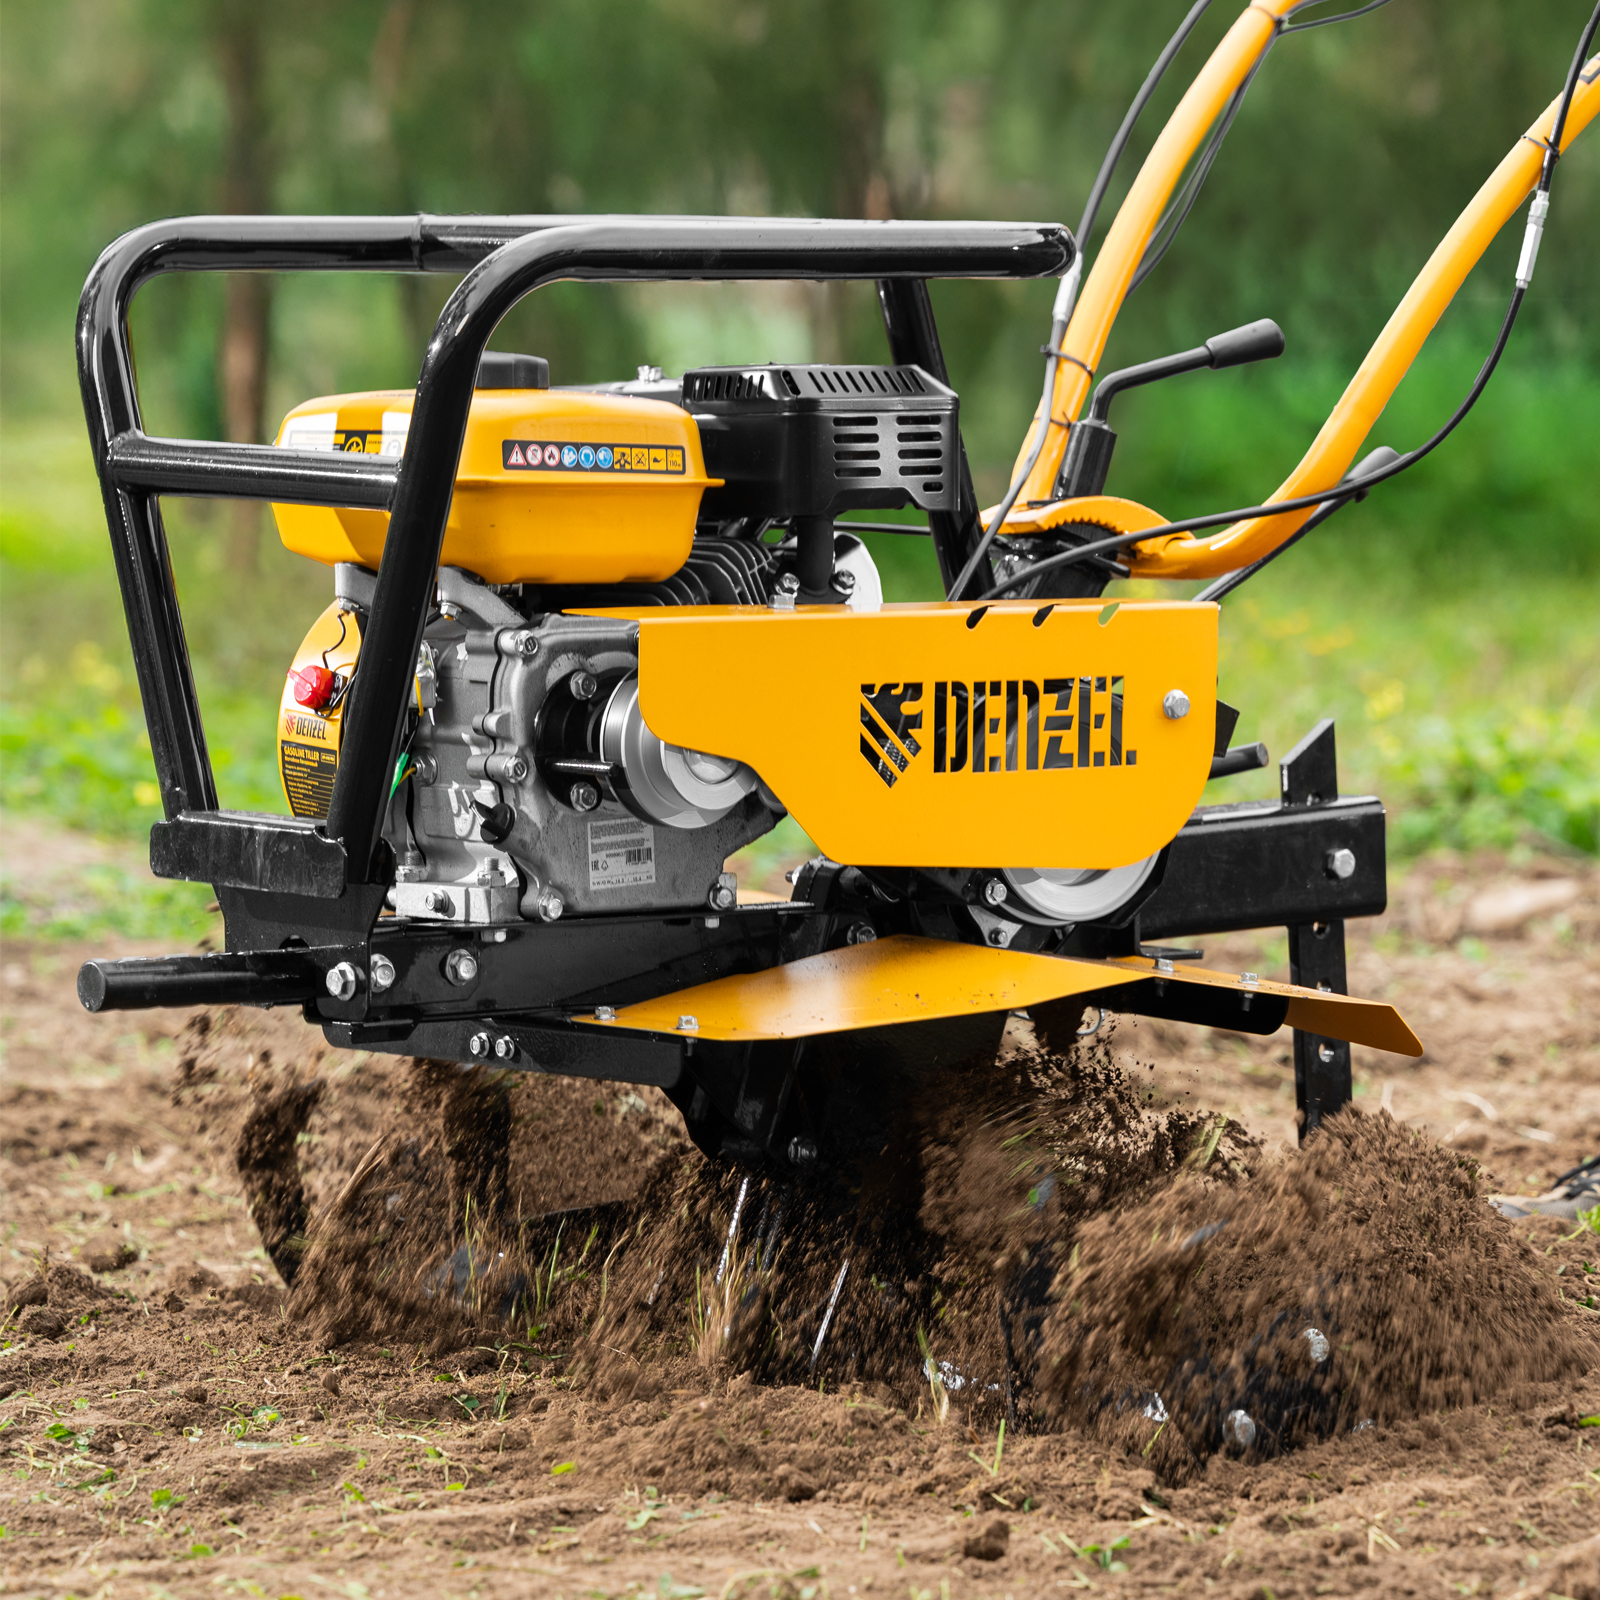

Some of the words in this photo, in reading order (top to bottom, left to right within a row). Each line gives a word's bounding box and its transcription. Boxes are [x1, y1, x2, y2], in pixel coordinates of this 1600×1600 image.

[296, 716, 326, 740] DENZEL
[934, 676, 1136, 773] DENZEL
[284, 745, 305, 759] GASOLINE
[305, 749, 320, 762] TILLER
